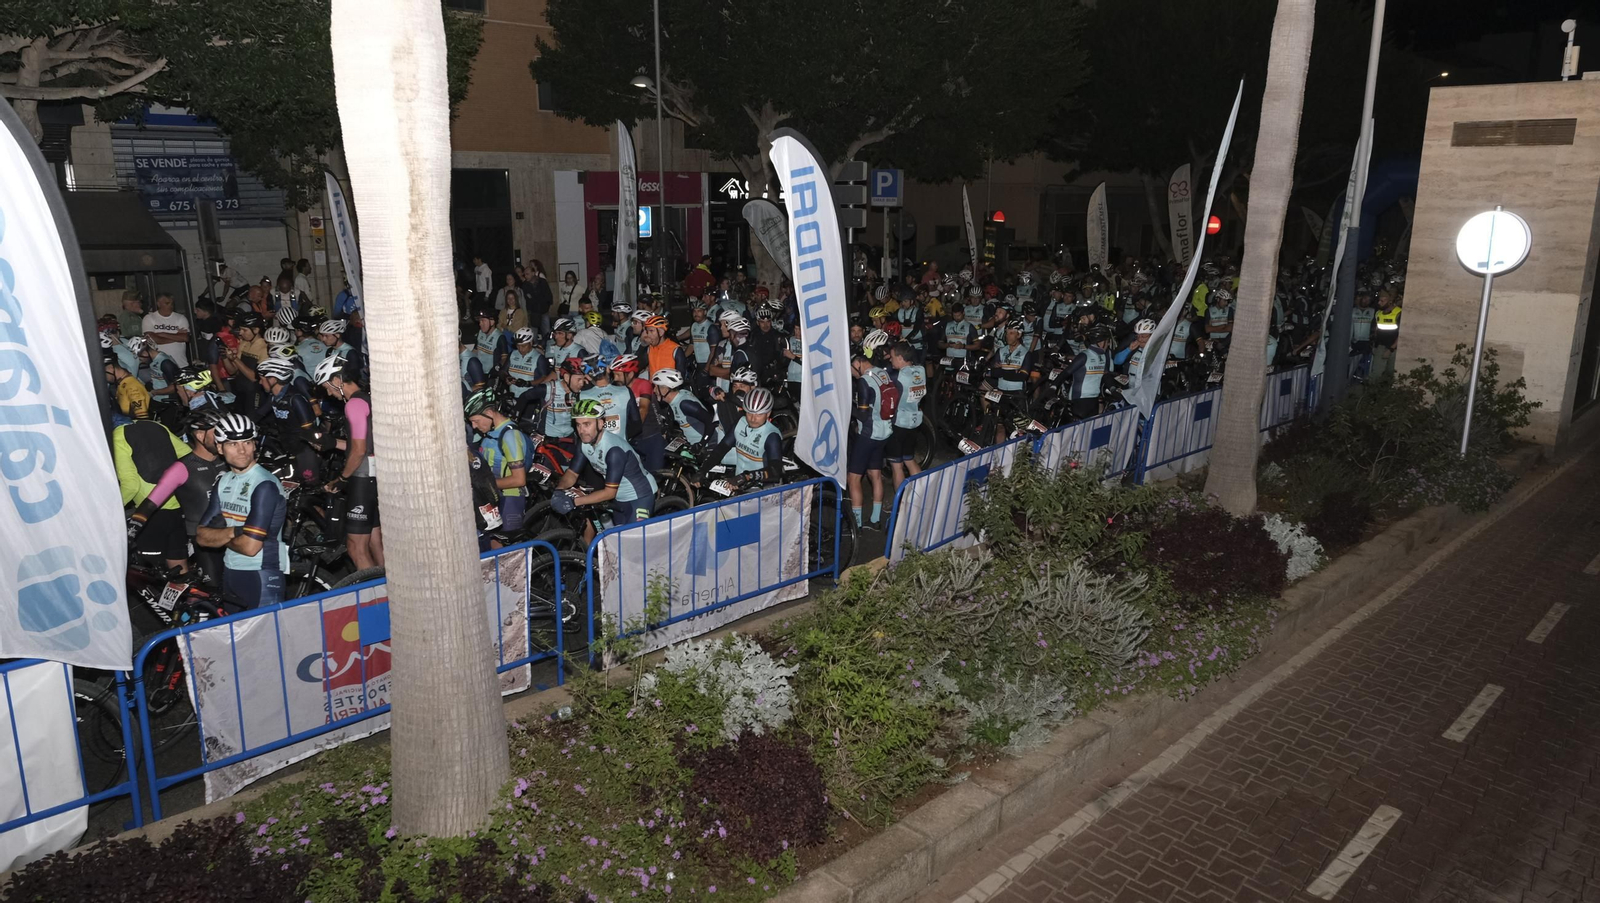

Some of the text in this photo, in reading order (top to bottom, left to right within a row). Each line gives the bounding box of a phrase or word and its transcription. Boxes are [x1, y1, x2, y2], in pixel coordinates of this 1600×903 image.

[136, 158, 187, 168] SE VENDE
[151, 173, 180, 185] Aparca
[192, 173, 200, 182] el
[877, 172, 893, 195] P
[157, 184, 224, 195] sin complicaciones
[169, 201, 190, 211] 675
[225, 199, 239, 209] 73
[154, 323, 179, 331] adidas
